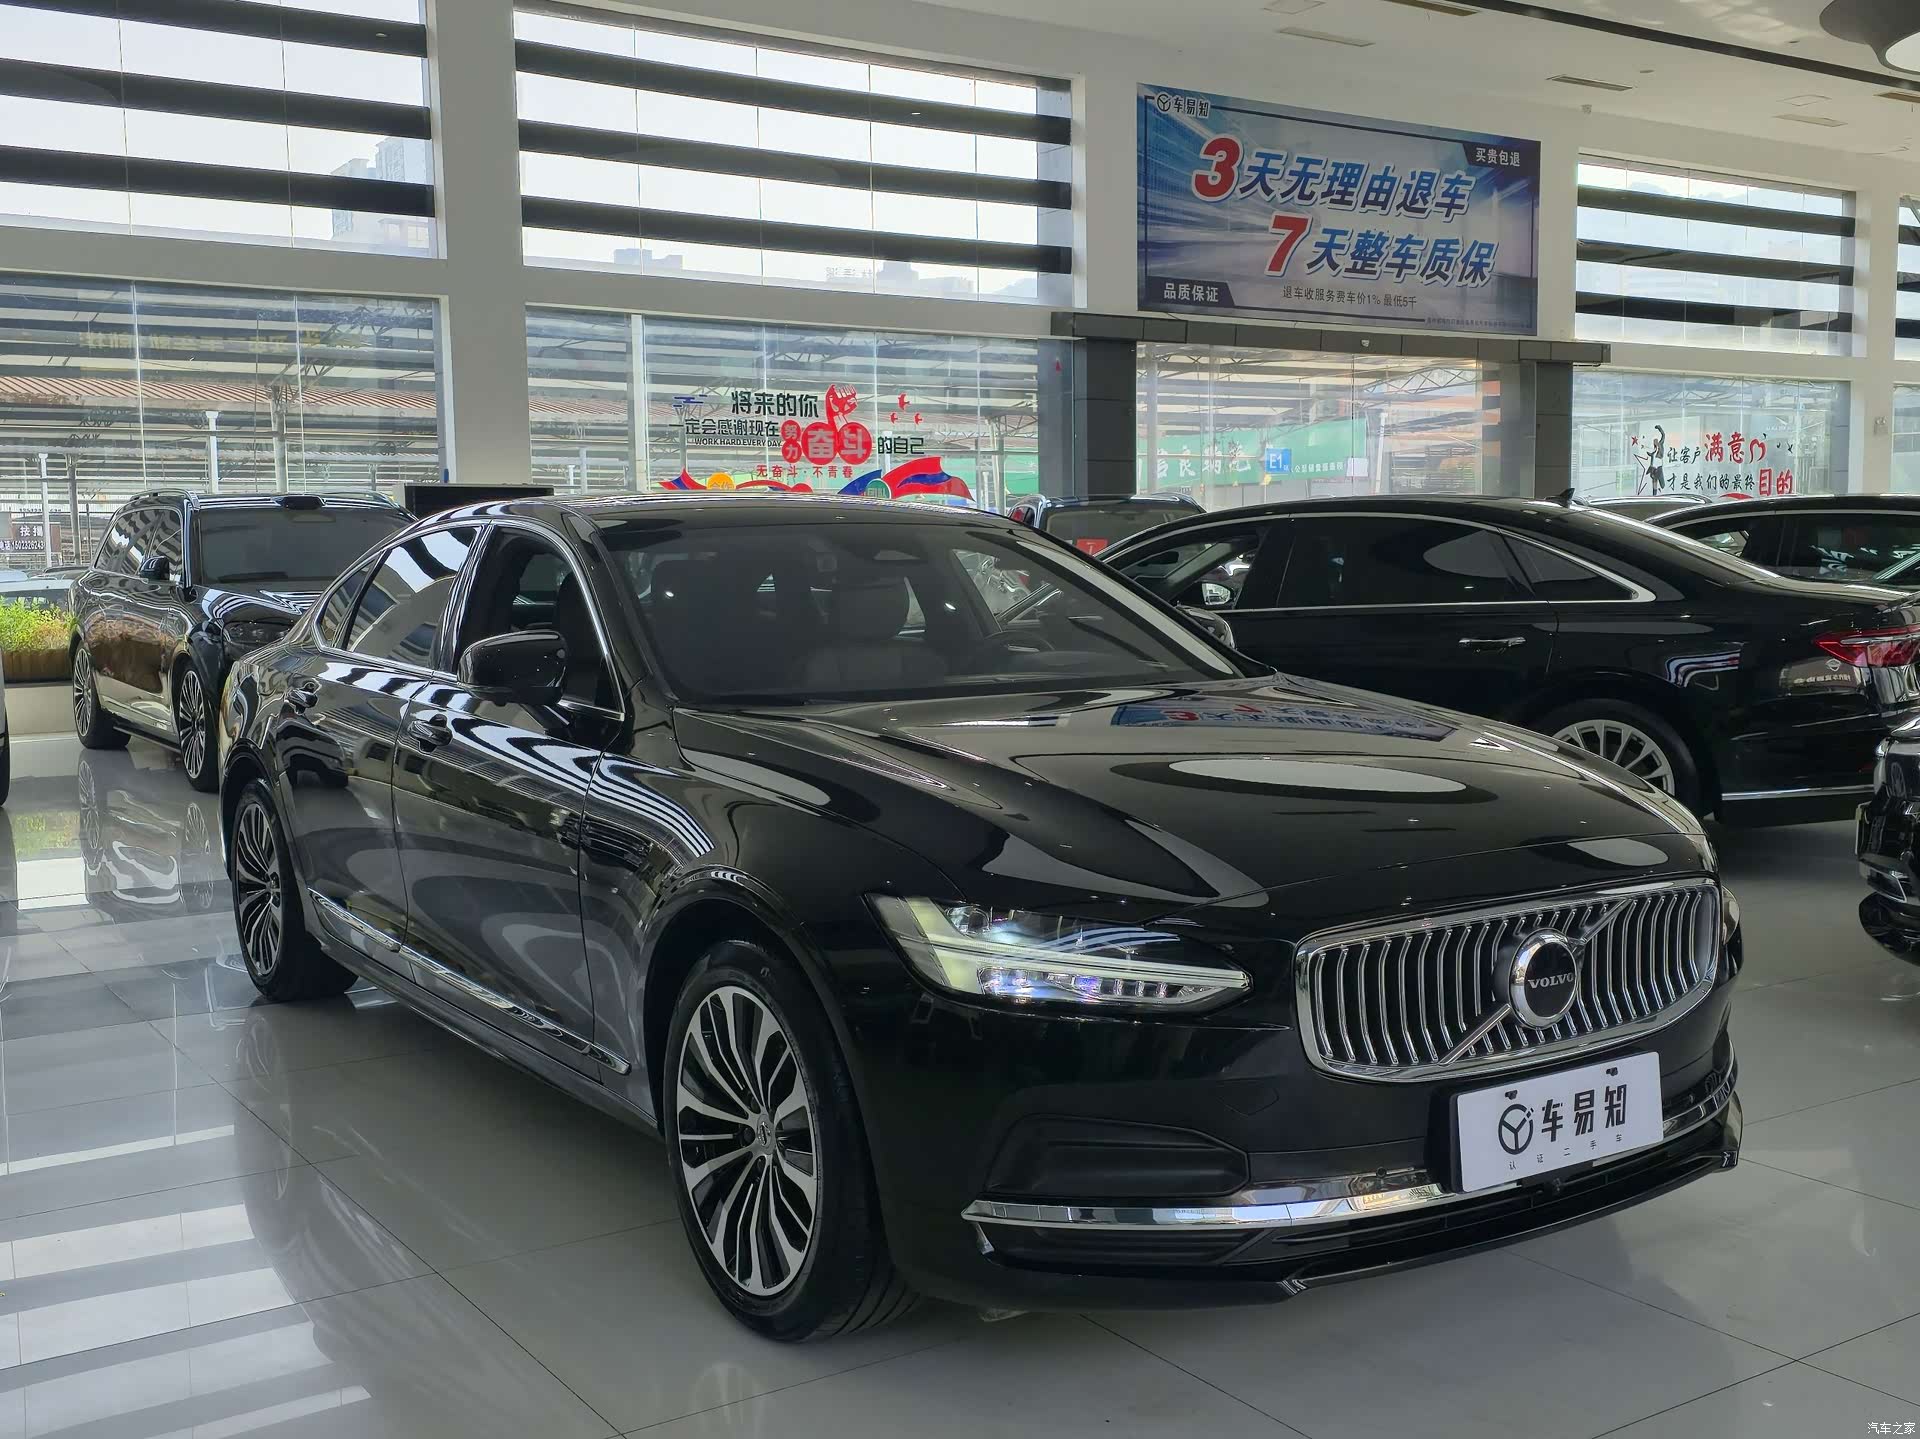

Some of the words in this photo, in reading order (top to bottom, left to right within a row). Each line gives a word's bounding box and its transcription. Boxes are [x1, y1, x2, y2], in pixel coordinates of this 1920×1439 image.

[1172, 97, 1211, 117] 车易知
[1475, 147, 1522, 167] 买贵包退
[1193, 137, 1475, 220] 3天无理由退车
[1266, 214, 1498, 287] 7天整车质保
[1163, 283, 1219, 303] 品质保证
[1283, 286, 1381, 306] 退车收服务费车价1%
[731, 390, 819, 418] 将来的你
[669, 418, 781, 437] 一定会感谢现在
[785, 425, 798, 459] 努力
[808, 429, 868, 459] 奋斗
[877, 436, 925, 454] 的自己
[1269, 452, 1284, 469] E1
[1667, 468, 1793, 496] 才是我们的最终目的
[1528, 972, 1574, 990] VOLVO
[1541, 1084, 1627, 1142] 车易知
[1509, 1133, 1622, 1170] 认证二手车
